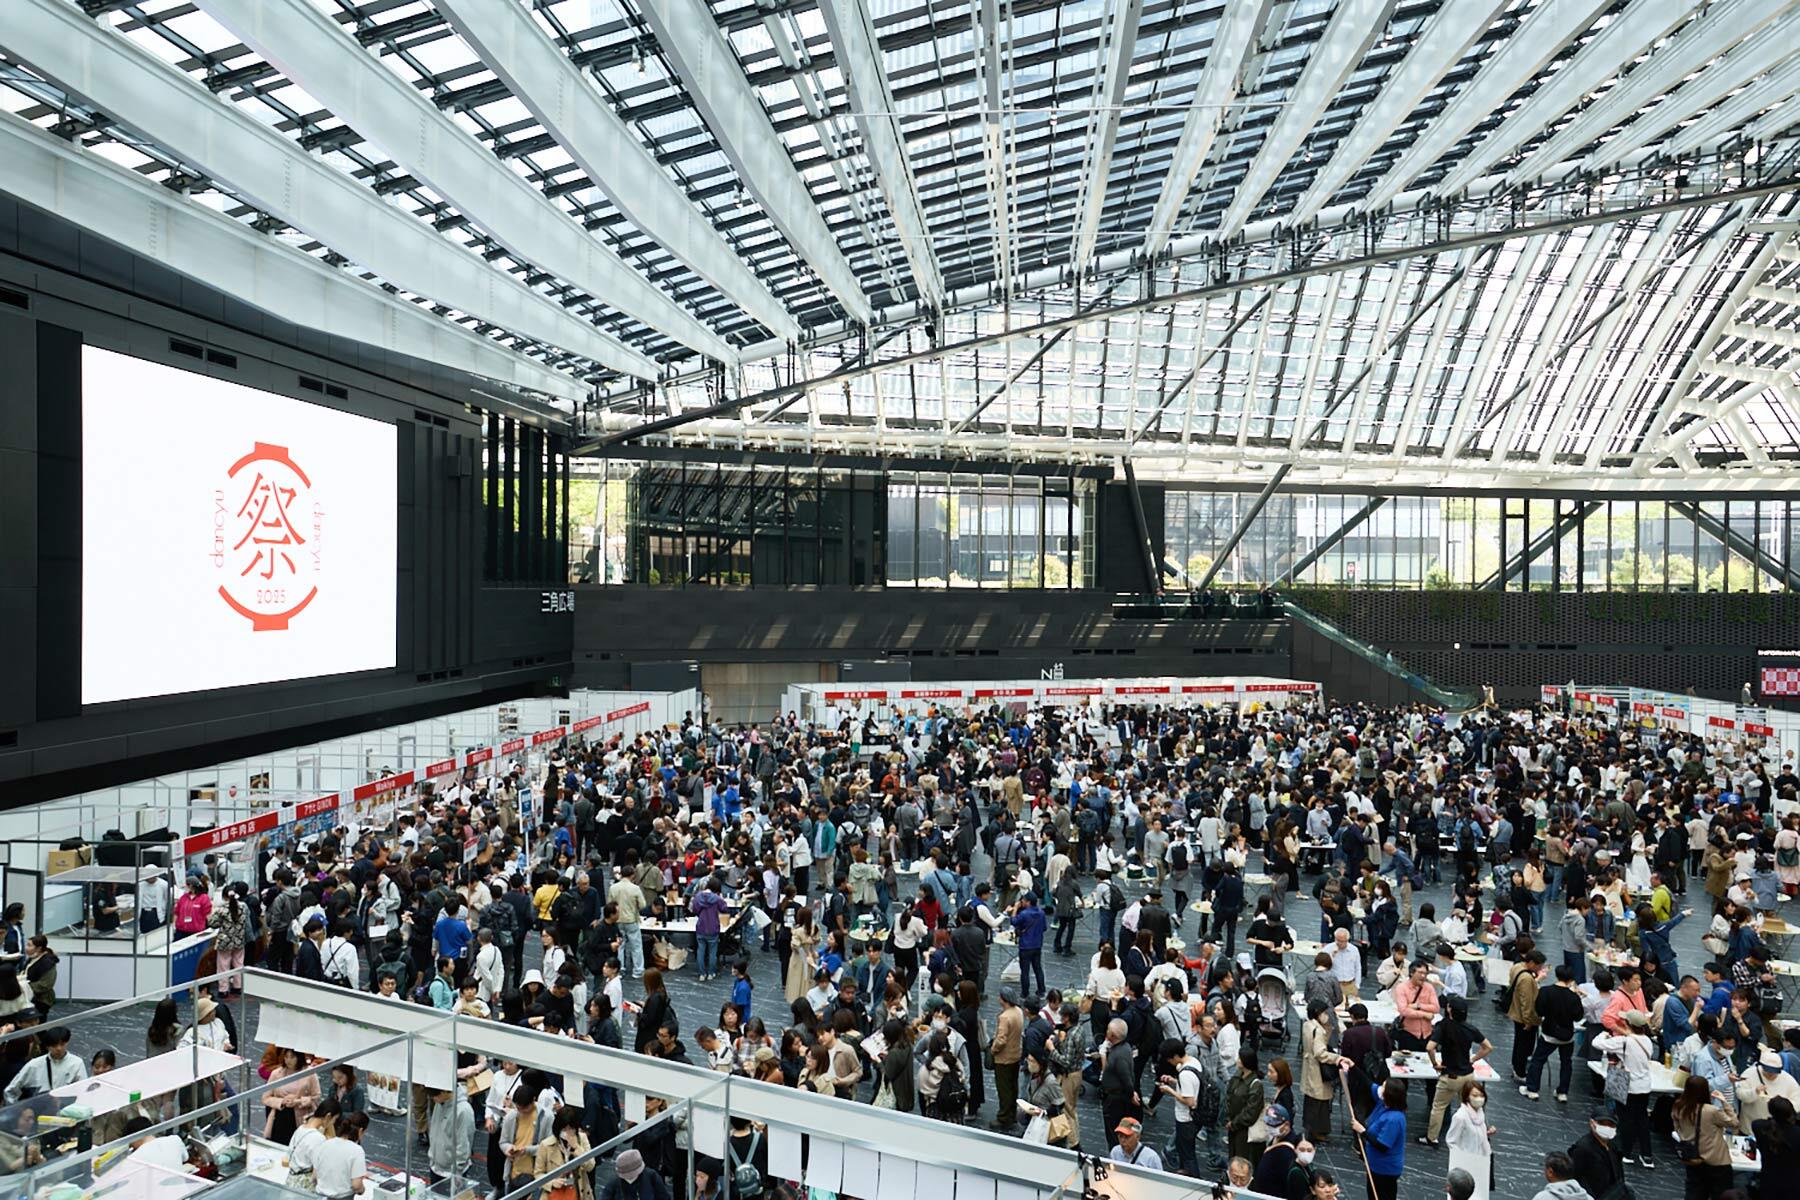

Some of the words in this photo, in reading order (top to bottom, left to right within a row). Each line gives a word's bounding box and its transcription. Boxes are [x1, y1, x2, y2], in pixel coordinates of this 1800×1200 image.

[209, 490, 228, 568] dancyu
[233, 472, 306, 580] 祭
[256, 589, 286, 604] 2025
[212, 822, 257, 845] 加藤牛肉店
